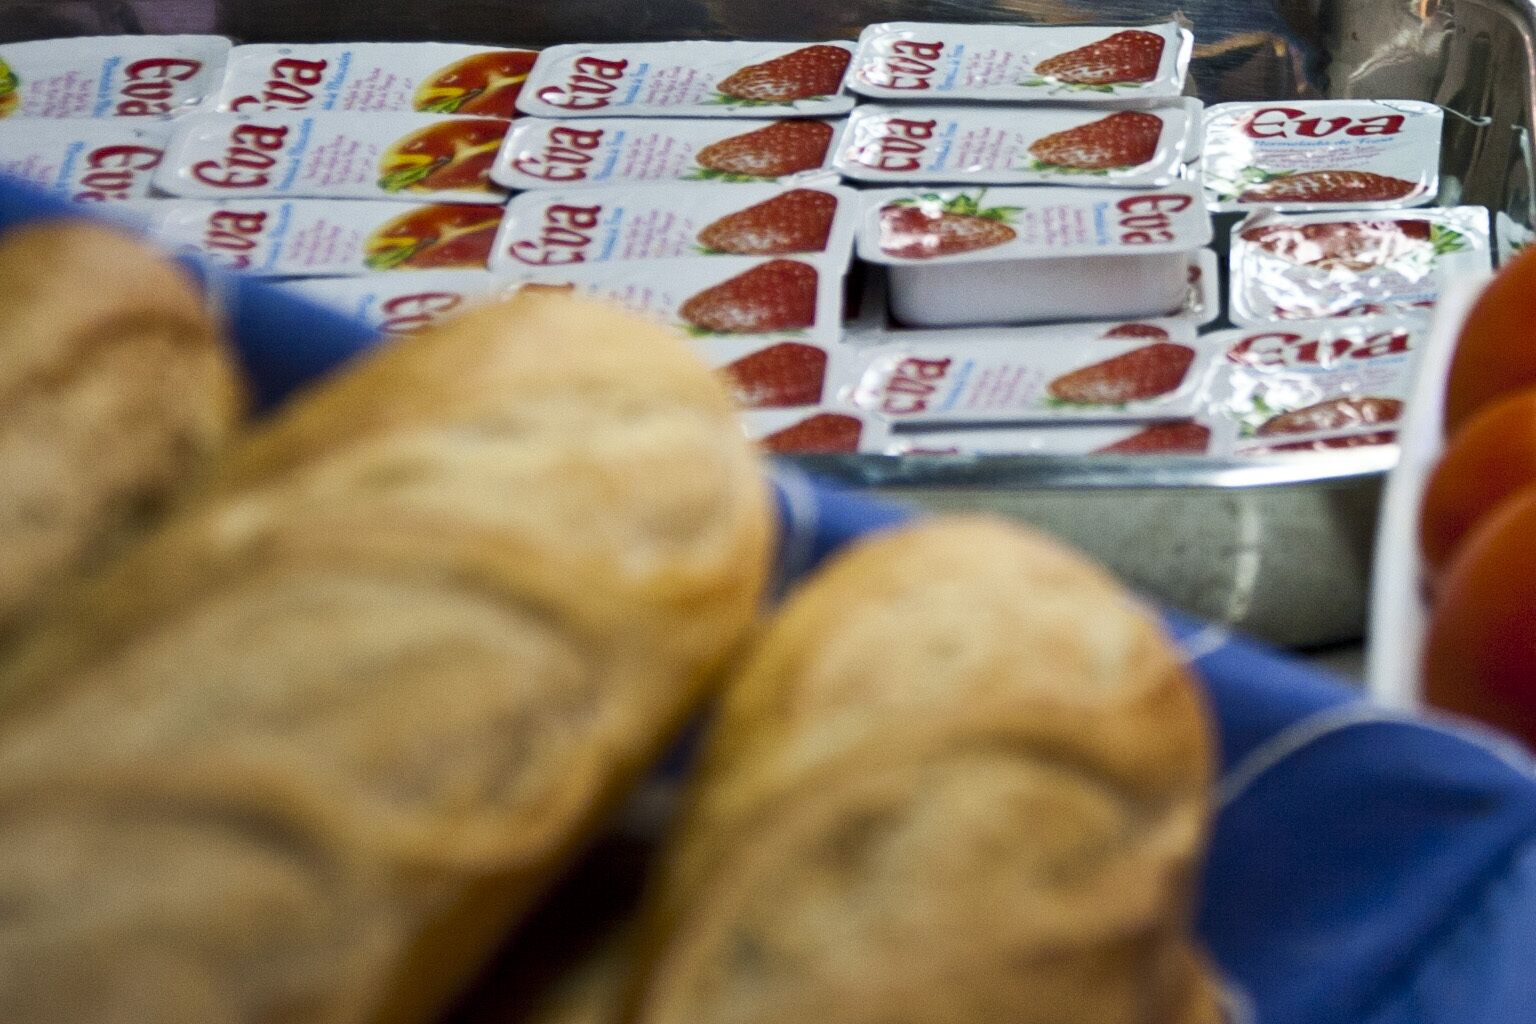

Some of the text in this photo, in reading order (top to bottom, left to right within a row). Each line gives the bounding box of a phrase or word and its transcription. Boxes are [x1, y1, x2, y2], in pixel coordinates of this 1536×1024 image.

[538, 56, 629, 110] Eva
[857, 39, 945, 90] Eva
[848, 117, 937, 172] Eva
[1241, 107, 1406, 139] Eva
[191, 123, 289, 188] Eva
[512, 126, 605, 182] Eva
[508, 203, 602, 266] Eva
[1226, 332, 1412, 366] Eva
